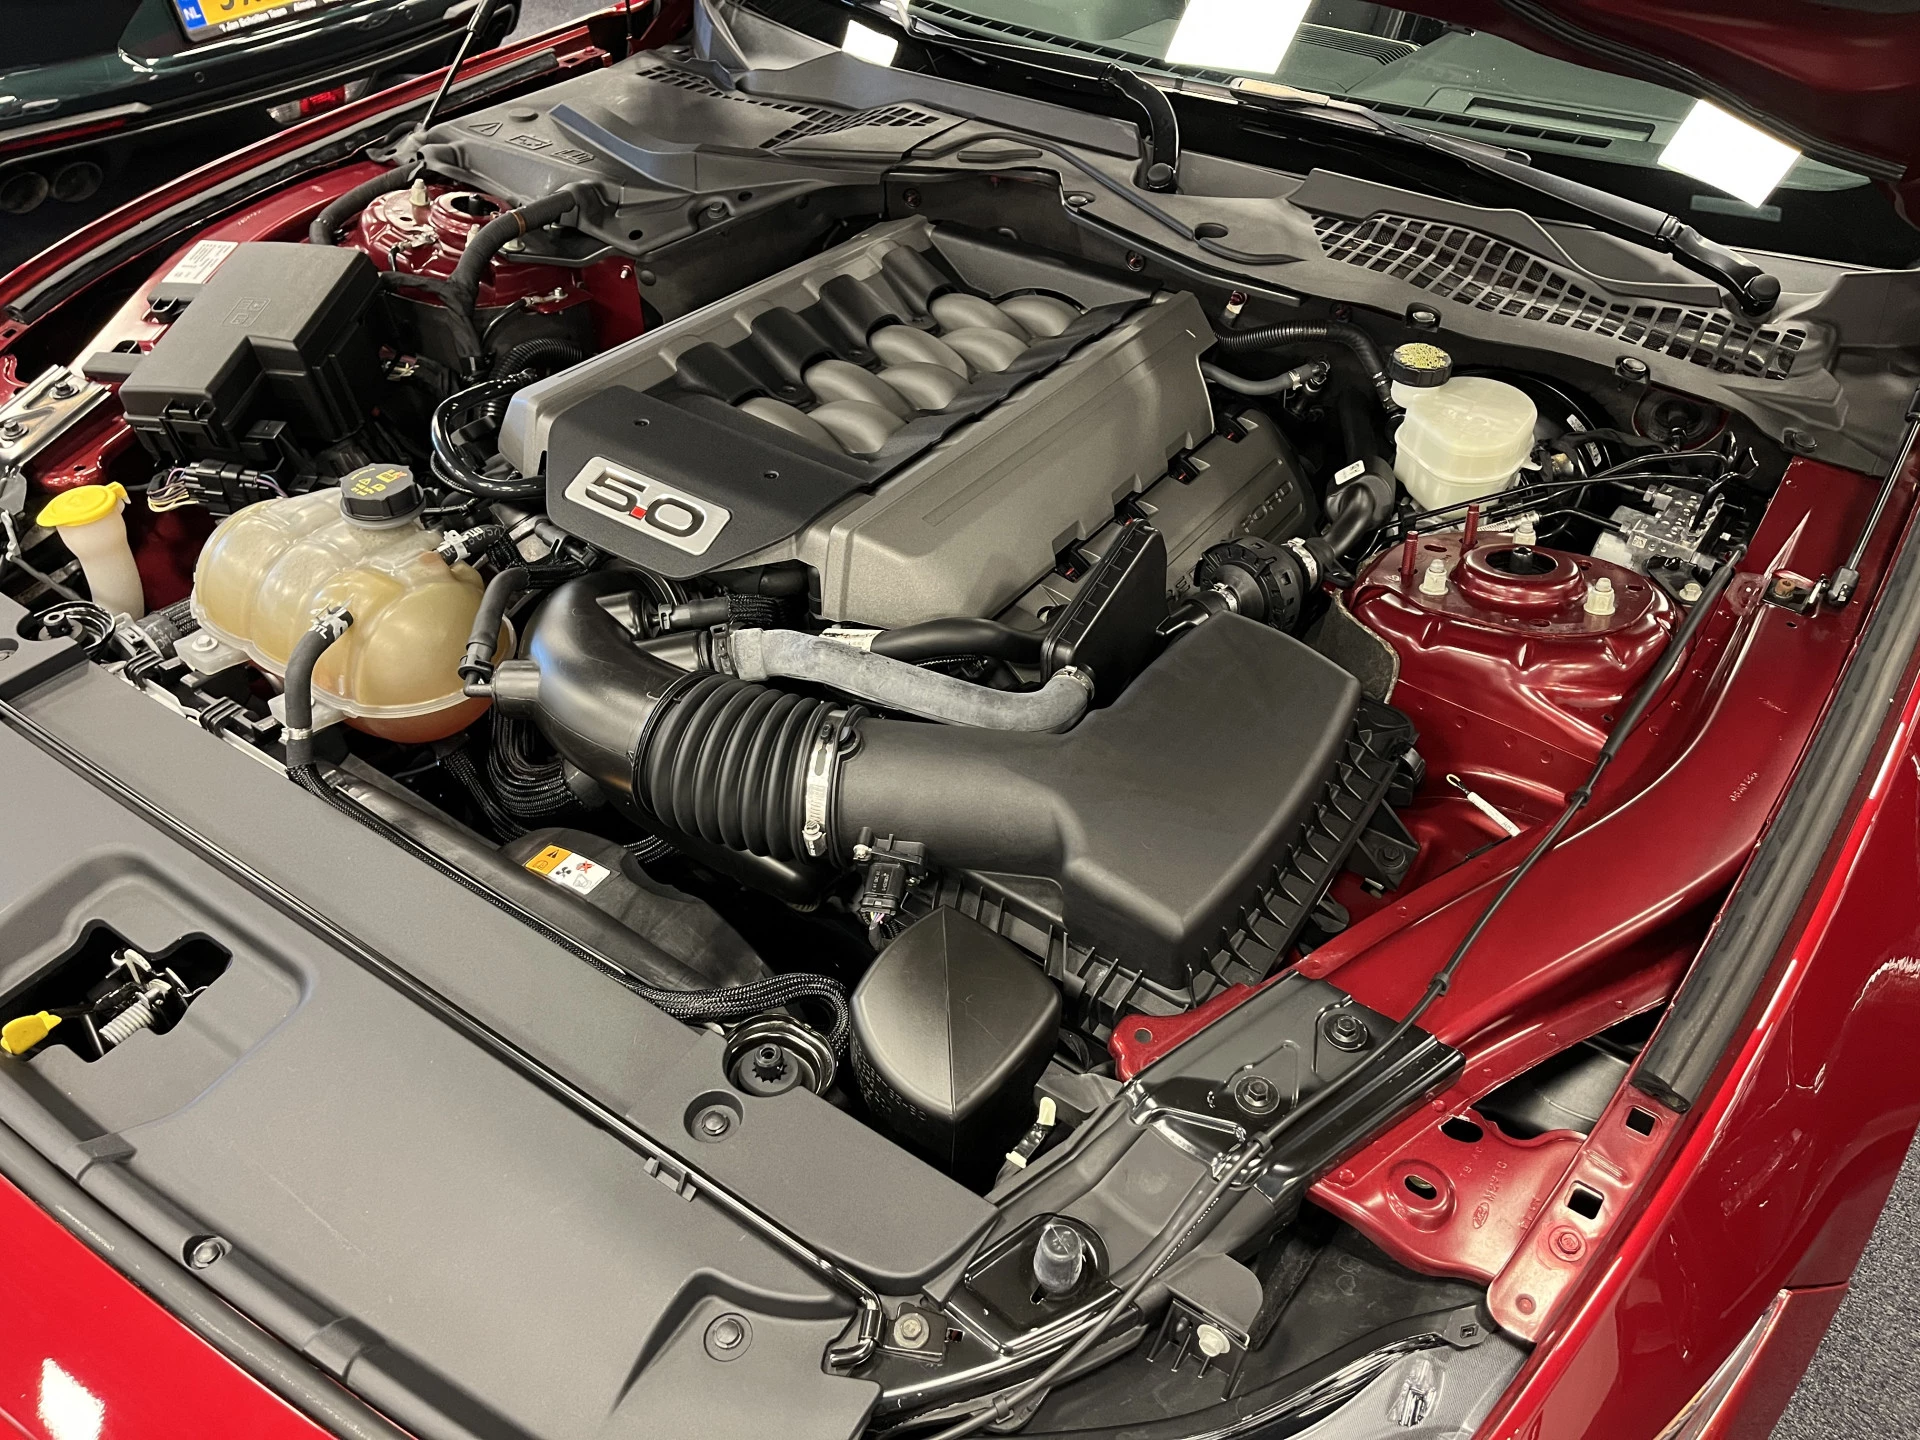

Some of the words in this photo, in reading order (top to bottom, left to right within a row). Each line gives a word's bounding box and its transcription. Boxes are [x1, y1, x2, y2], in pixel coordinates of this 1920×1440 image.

[183, 6, 202, 21] NL
[585, 466, 706, 538] 5.0
[1241, 480, 1294, 533] FORD
